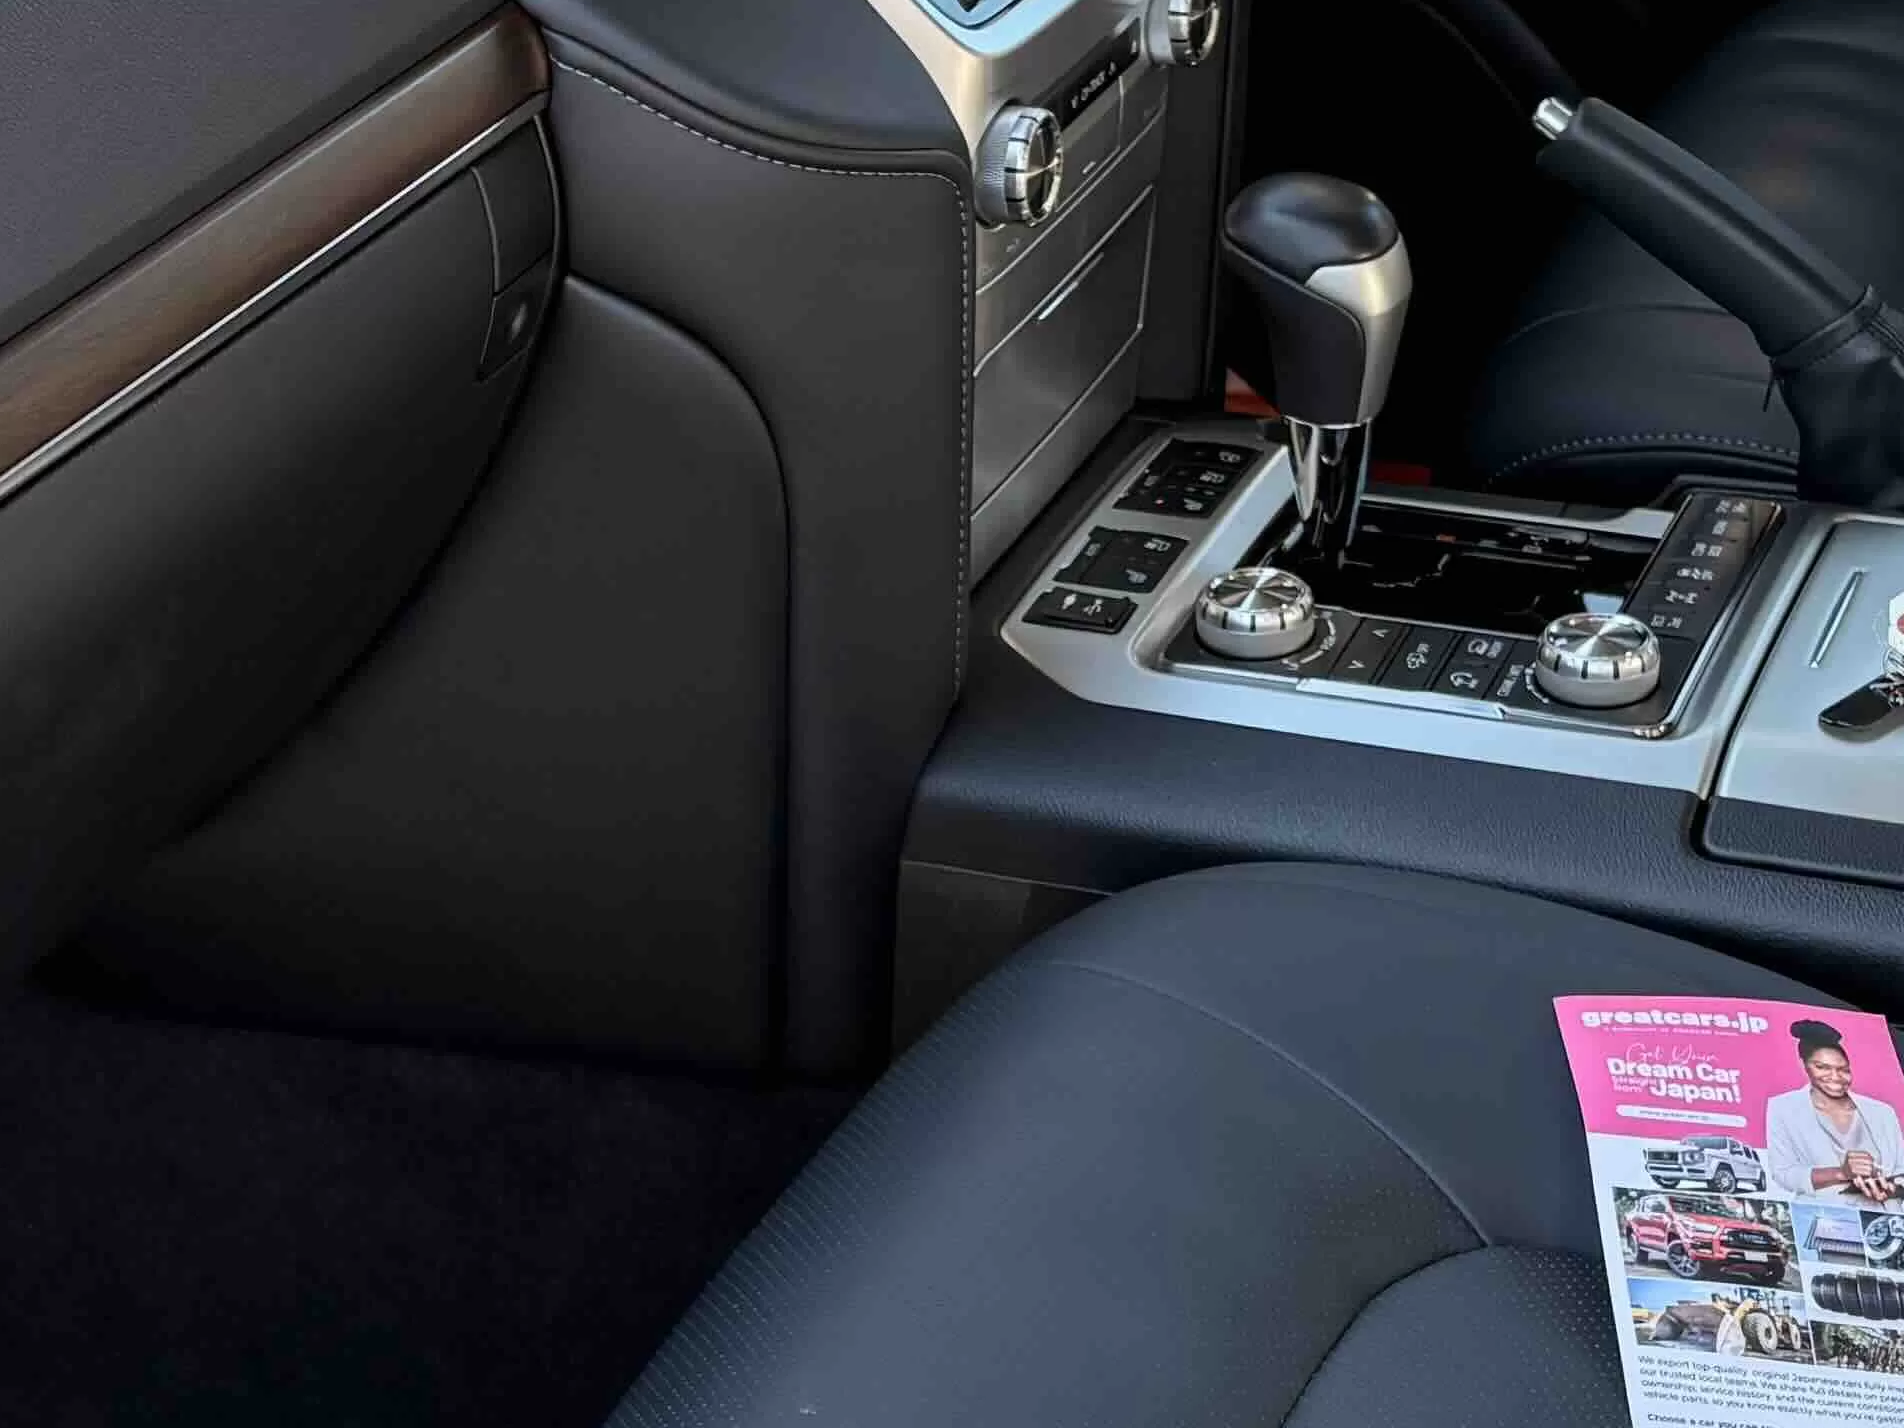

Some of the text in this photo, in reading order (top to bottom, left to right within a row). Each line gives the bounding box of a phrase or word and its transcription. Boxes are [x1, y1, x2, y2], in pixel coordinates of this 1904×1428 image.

[1581, 1009, 1769, 1034] greatcars.jp
[1607, 1057, 1741, 1084] Dream Car
[1649, 1078, 1742, 1104] Japan!
[1638, 1355, 1655, 1365] We
[1647, 1412, 1687, 1424] Choose
